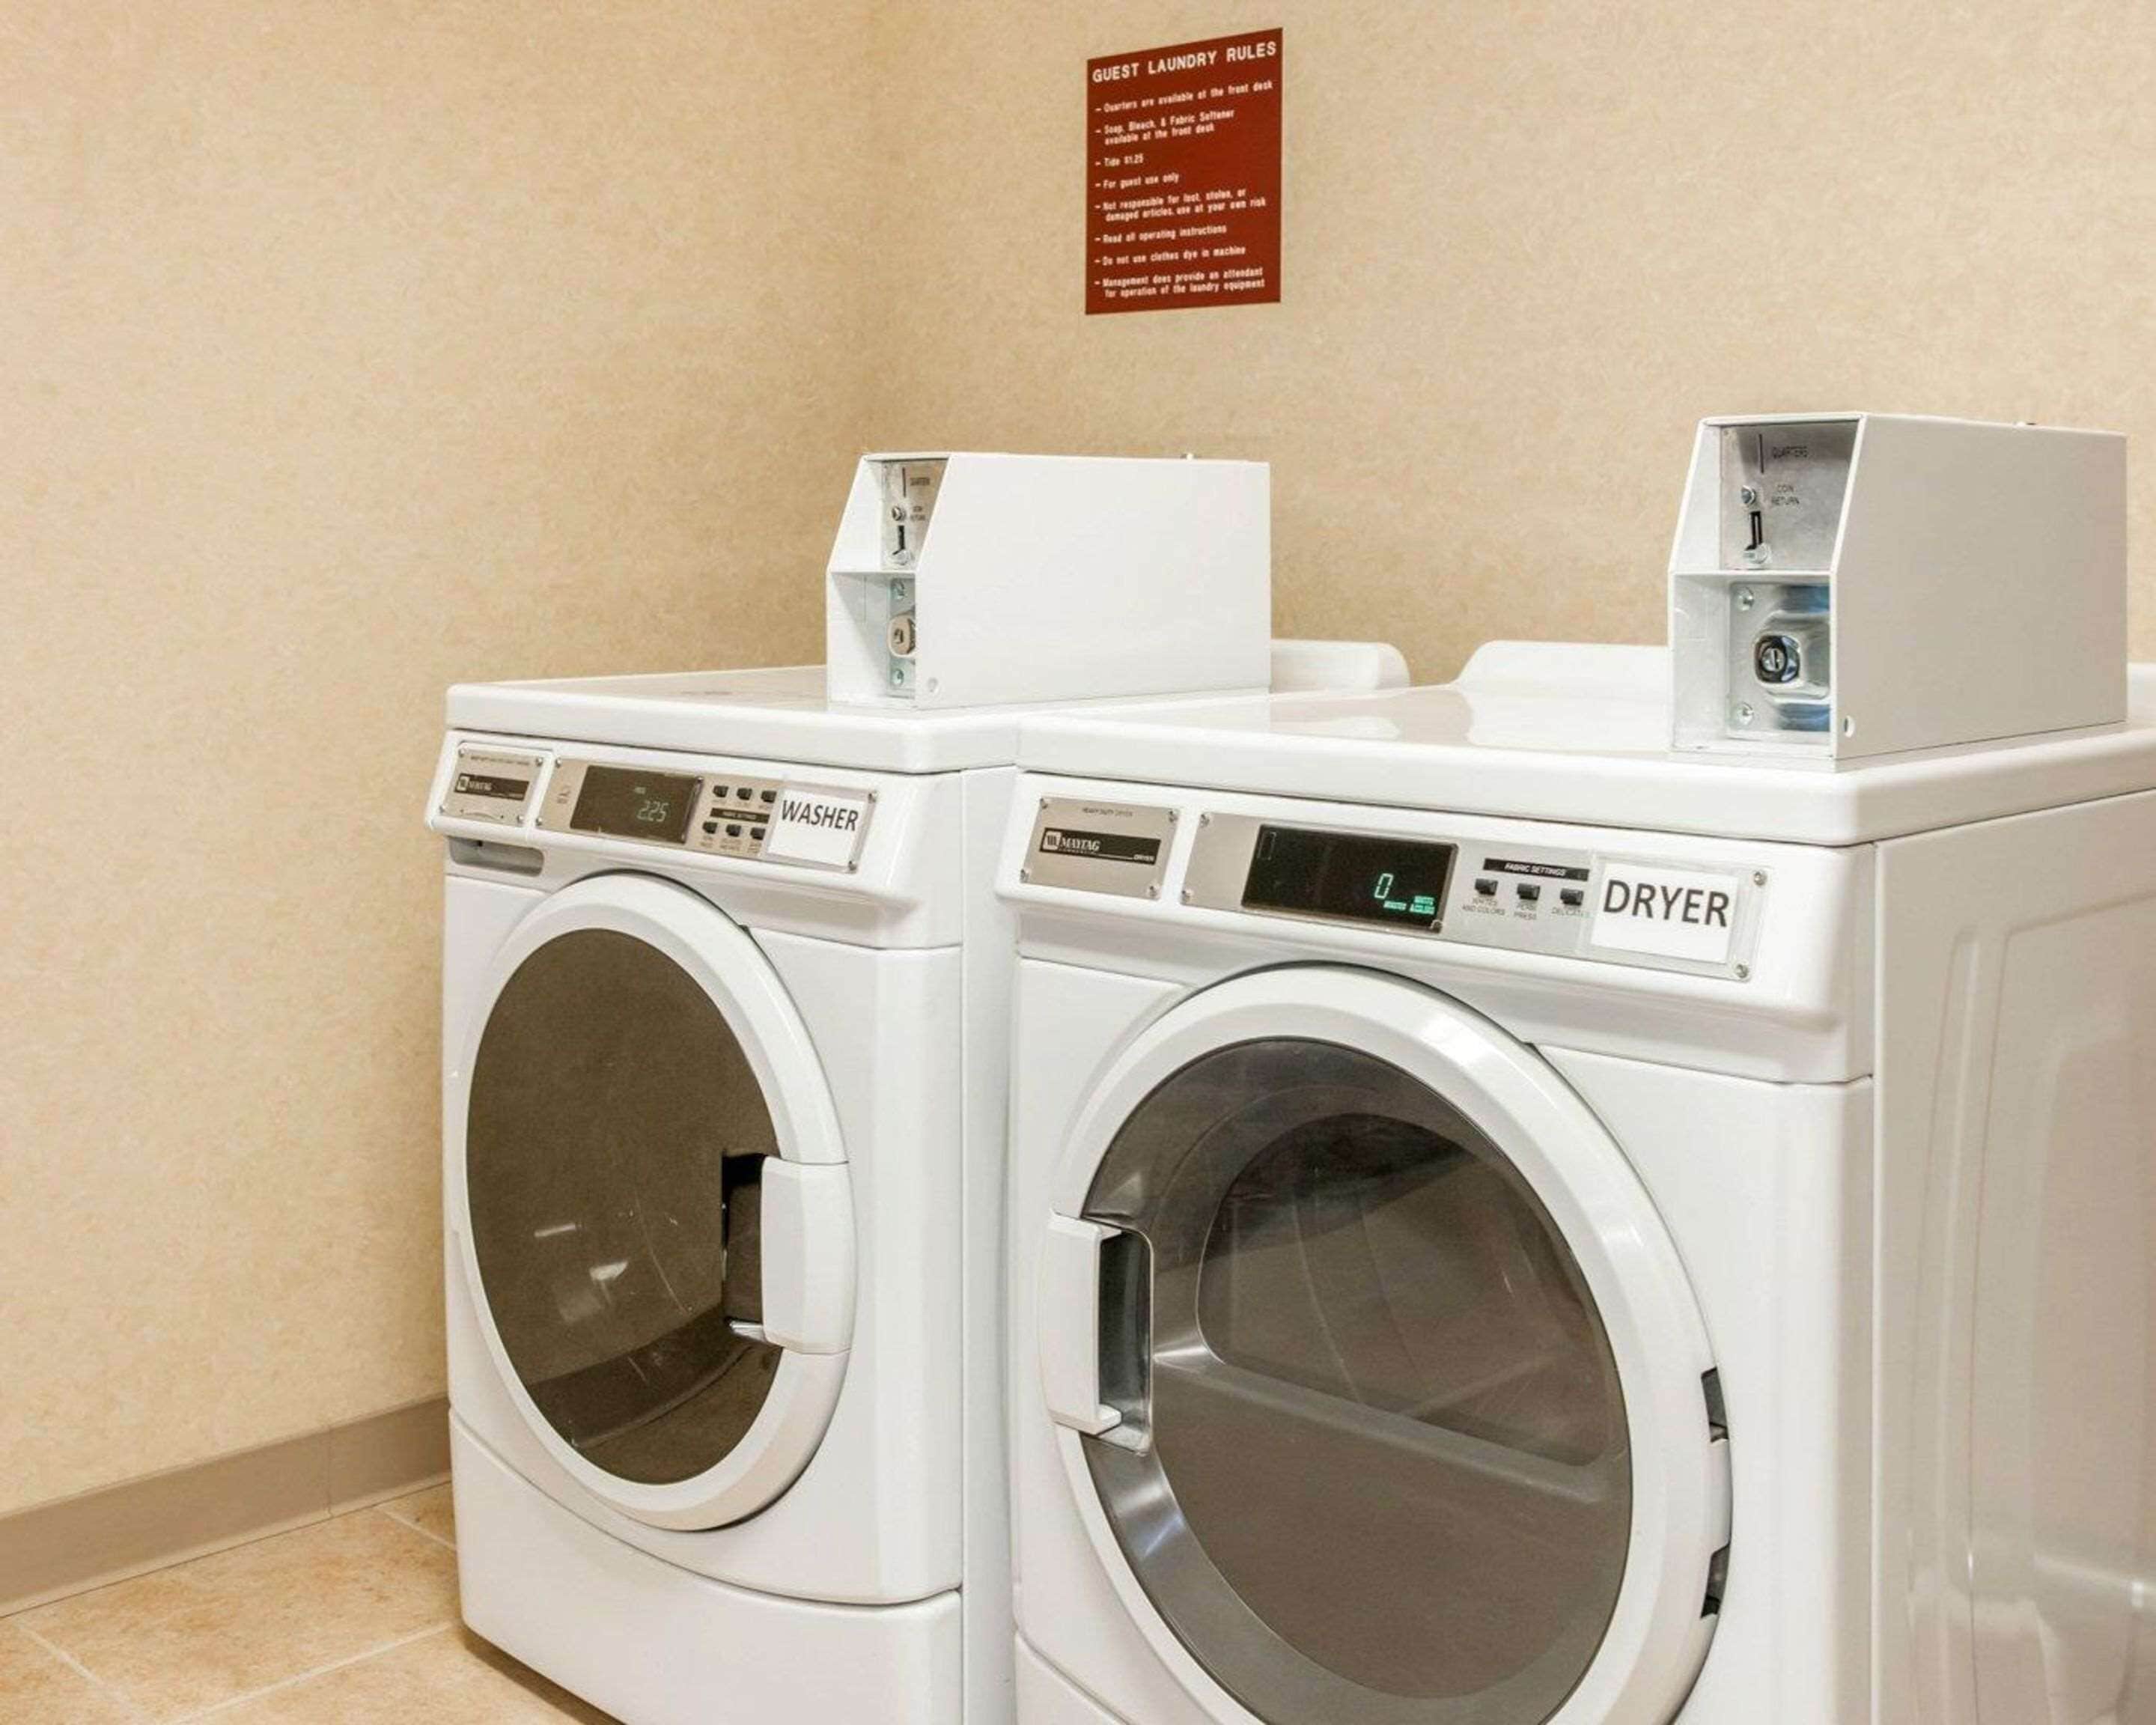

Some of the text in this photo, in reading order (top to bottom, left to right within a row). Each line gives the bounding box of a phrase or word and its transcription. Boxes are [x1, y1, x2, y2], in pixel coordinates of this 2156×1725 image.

[1091, 40, 1276, 83] GUEST LAUNDRY RULES
[1103, 79, 1273, 113] Quarters are available at the front desk
[1169, 115, 1196, 126] Fabric
[1199, 109, 1234, 122] Softener
[1104, 122, 1215, 146] available at the front desk
[1103, 157, 1121, 167] Tide
[1103, 171, 1180, 189] For guest use only
[1103, 201, 1117, 211] Not
[1119, 196, 1164, 210] responsible
[1167, 195, 1180, 204] for
[1237, 188, 1246, 198] or
[1105, 210, 1139, 222] damaged
[1176, 206, 1191, 216] use
[1194, 203, 1204, 213] at
[1207, 202, 1225, 213] your
[1229, 200, 1246, 210] own
[1249, 196, 1267, 207] risk
[1102, 225, 1228, 243] Read all operating instructions
[1102, 245, 1246, 267] Do not use clothes dye in machine
[1102, 267, 1264, 288] Management does provide an attendant
[1104, 278, 1265, 299] for operation of the laundry equipment
[781, 799, 859, 831] WASHER
[1060, 836, 1101, 851] MAYTAG
[1504, 862, 1567, 877] FABRIC SETTINGS
[1603, 878, 1731, 928] DRYER
